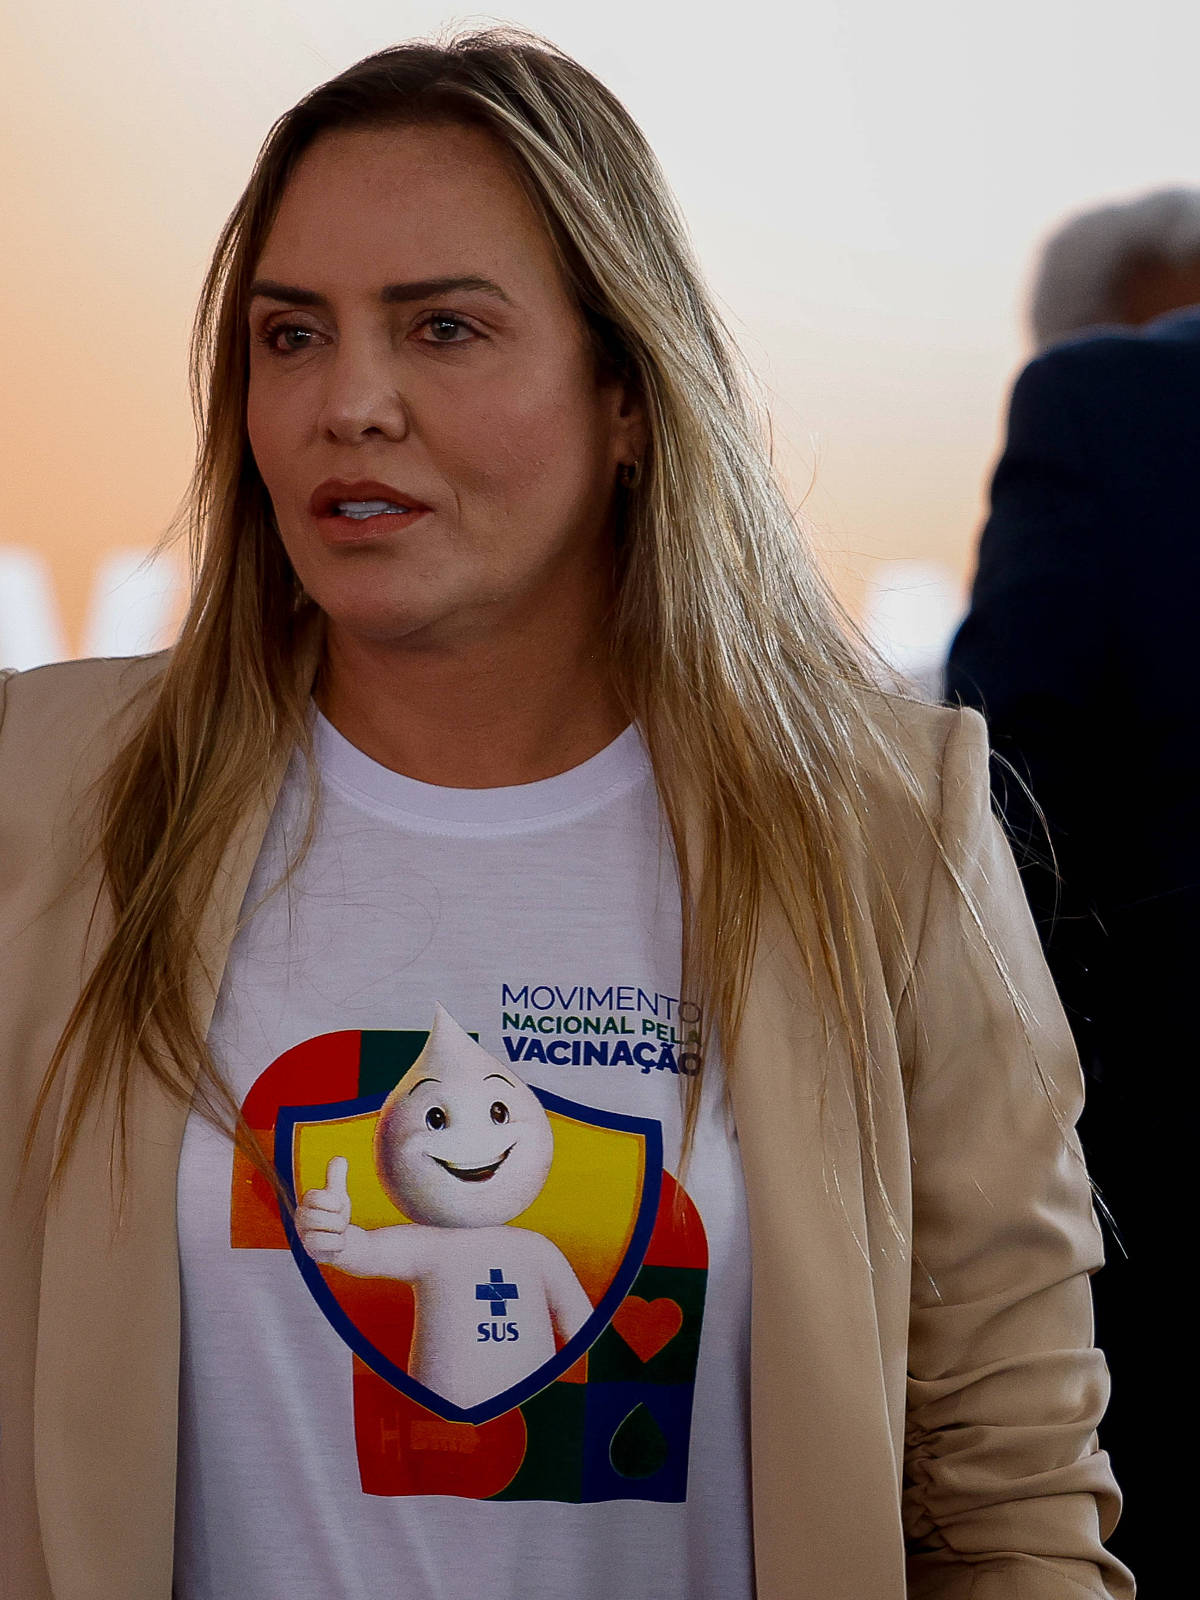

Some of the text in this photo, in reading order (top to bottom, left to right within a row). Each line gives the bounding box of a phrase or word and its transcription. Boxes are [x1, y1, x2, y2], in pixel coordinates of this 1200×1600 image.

[502, 983, 702, 1024] MOVIMENTO
[503, 1012, 635, 1036] NACIONAL
[502, 1035, 702, 1077] VACINAÇÃO
[477, 1322, 520, 1342] SUS
